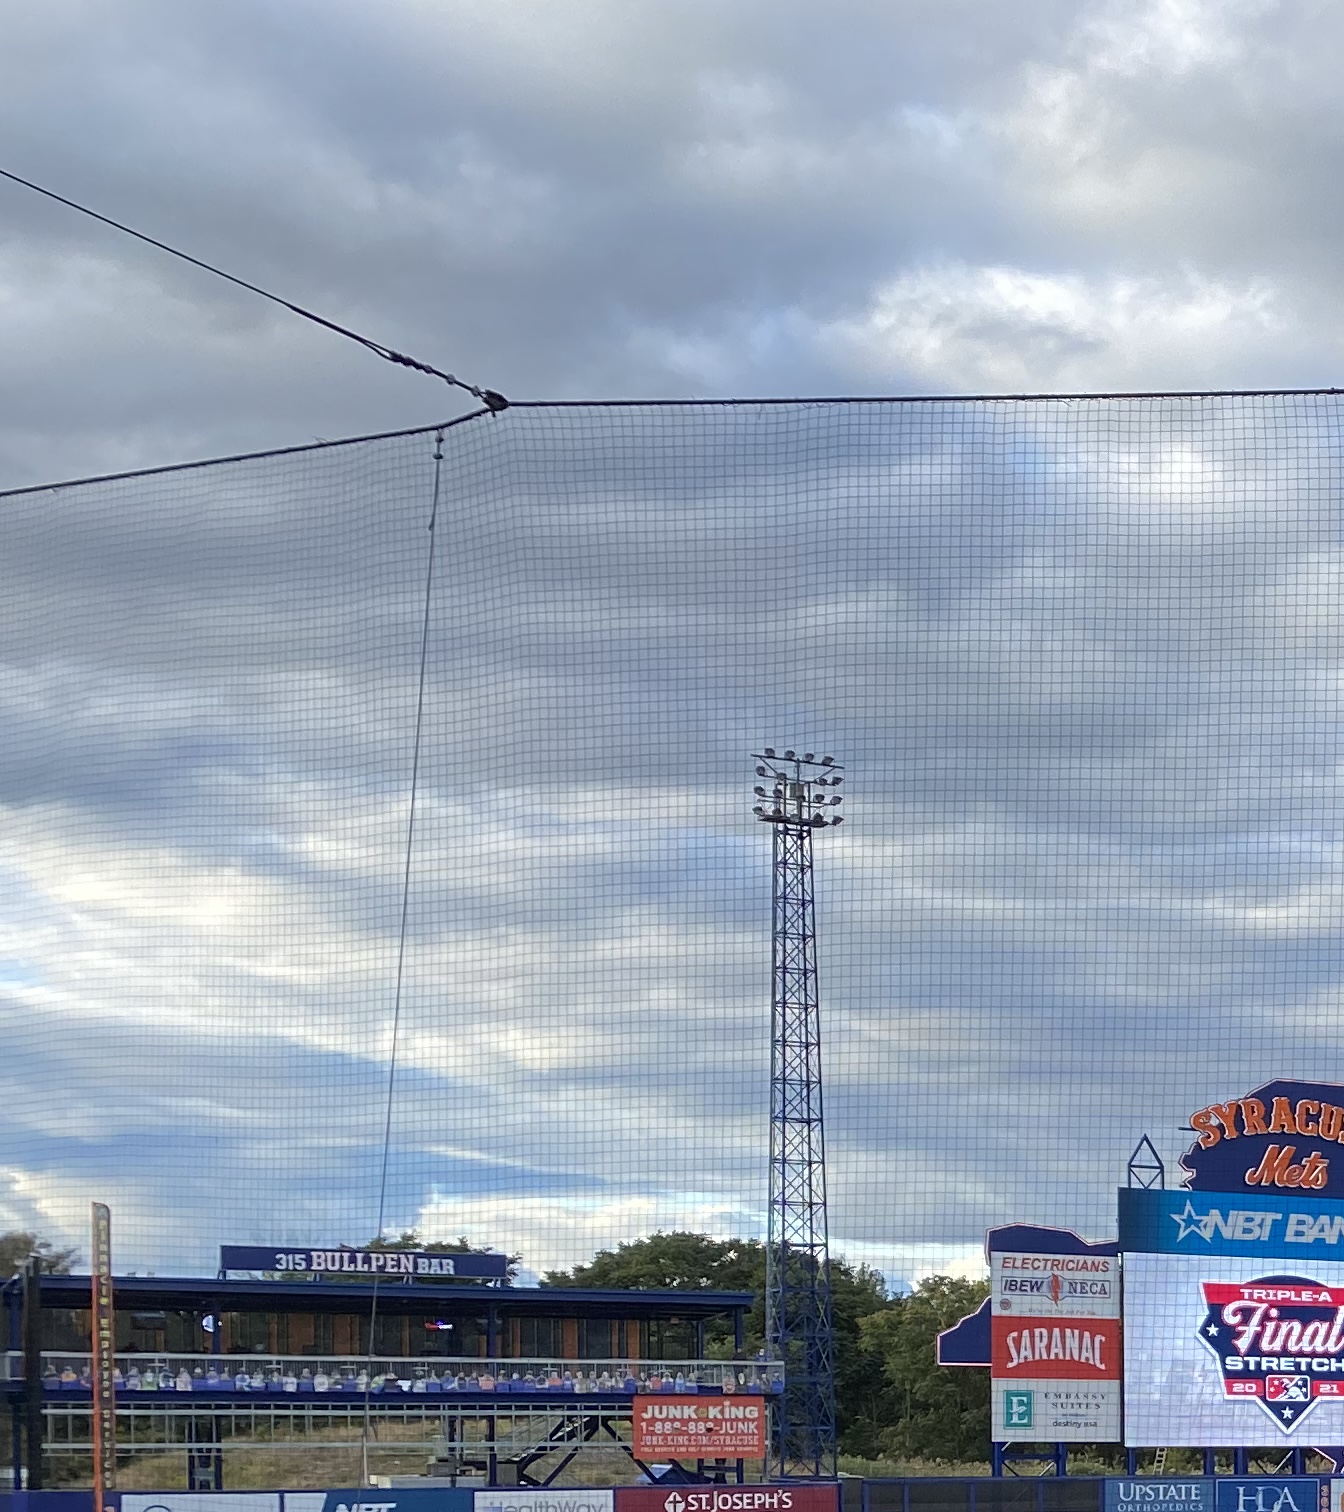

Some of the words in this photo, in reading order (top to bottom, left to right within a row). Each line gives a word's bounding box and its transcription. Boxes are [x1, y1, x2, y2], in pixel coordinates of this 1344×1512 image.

[1245, 1144, 1330, 1189] Mets
[1206, 1209, 1283, 1242] NBT
[275, 1253, 307, 1271] 315
[310, 1251, 414, 1273] BULLPEN
[416, 1257, 455, 1275] BAR
[1001, 1256, 1110, 1273] ELECTRICIANS
[1003, 1279, 1045, 1293] IBEW
[1067, 1281, 1108, 1295] NECA
[1240, 1289, 1332, 1302] TRIPLE-A
[1006, 1327, 1106, 1370] SARANAC
[1232, 1383, 1257, 1393] 20
[1319, 1384, 1339, 1393] 21
[1044, 1392, 1106, 1400] EMBASSY
[640, 1405, 698, 1419] JUNK
[1051, 1402, 1101, 1410] SUITES
[1052, 1418, 1082, 1429] destiny
[1083, 1420, 1098, 1428] usa
[1118, 1482, 1201, 1501] UPSTATE
[1117, 1503, 1203, 1512] ORTHOPEDICS
